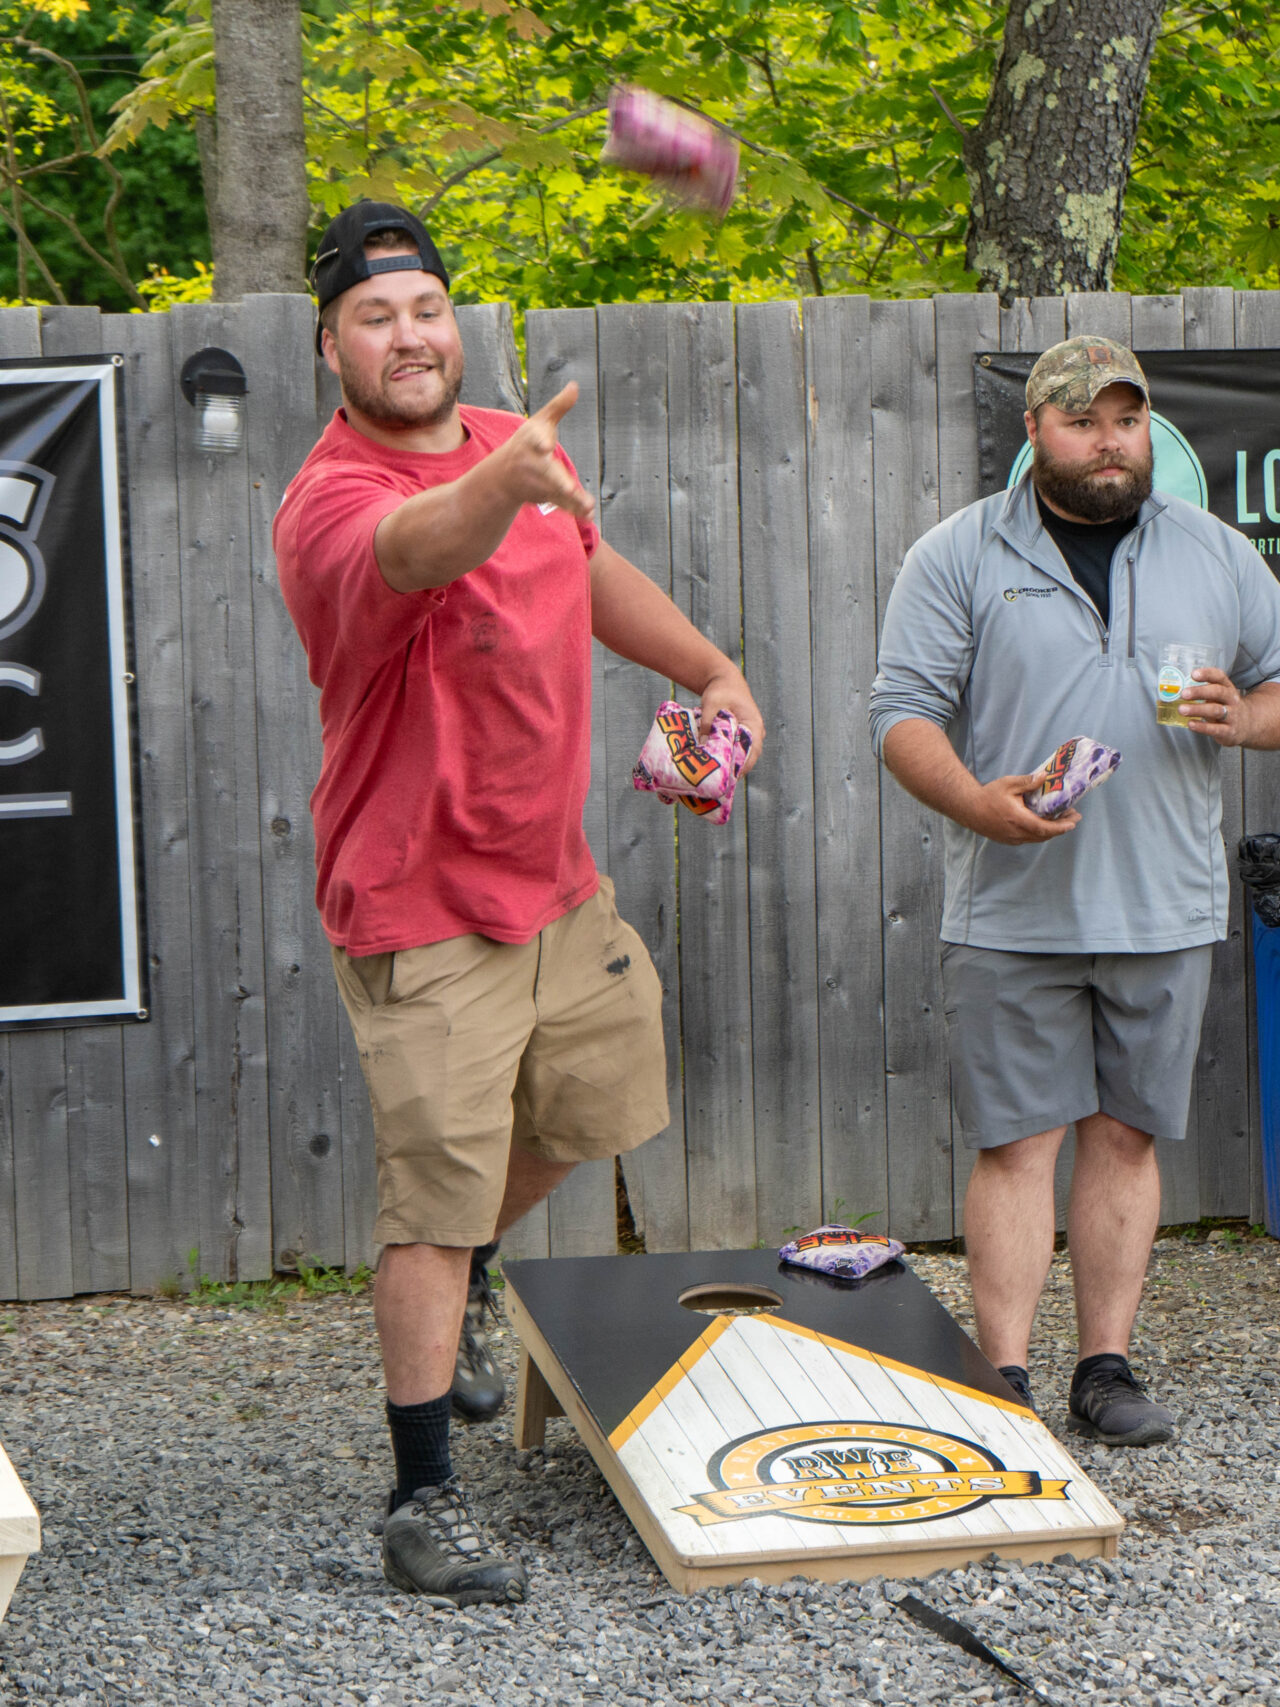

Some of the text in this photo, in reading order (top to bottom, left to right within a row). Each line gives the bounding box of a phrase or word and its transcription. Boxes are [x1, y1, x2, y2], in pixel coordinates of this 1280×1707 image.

[797, 1232, 892, 1253] FIRE
[813, 1425, 958, 1453] WICKED
[780, 1446, 922, 1481] RWE
[723, 1476, 1006, 1510] EVENTS
[864, 1499, 952, 1520] 2024
